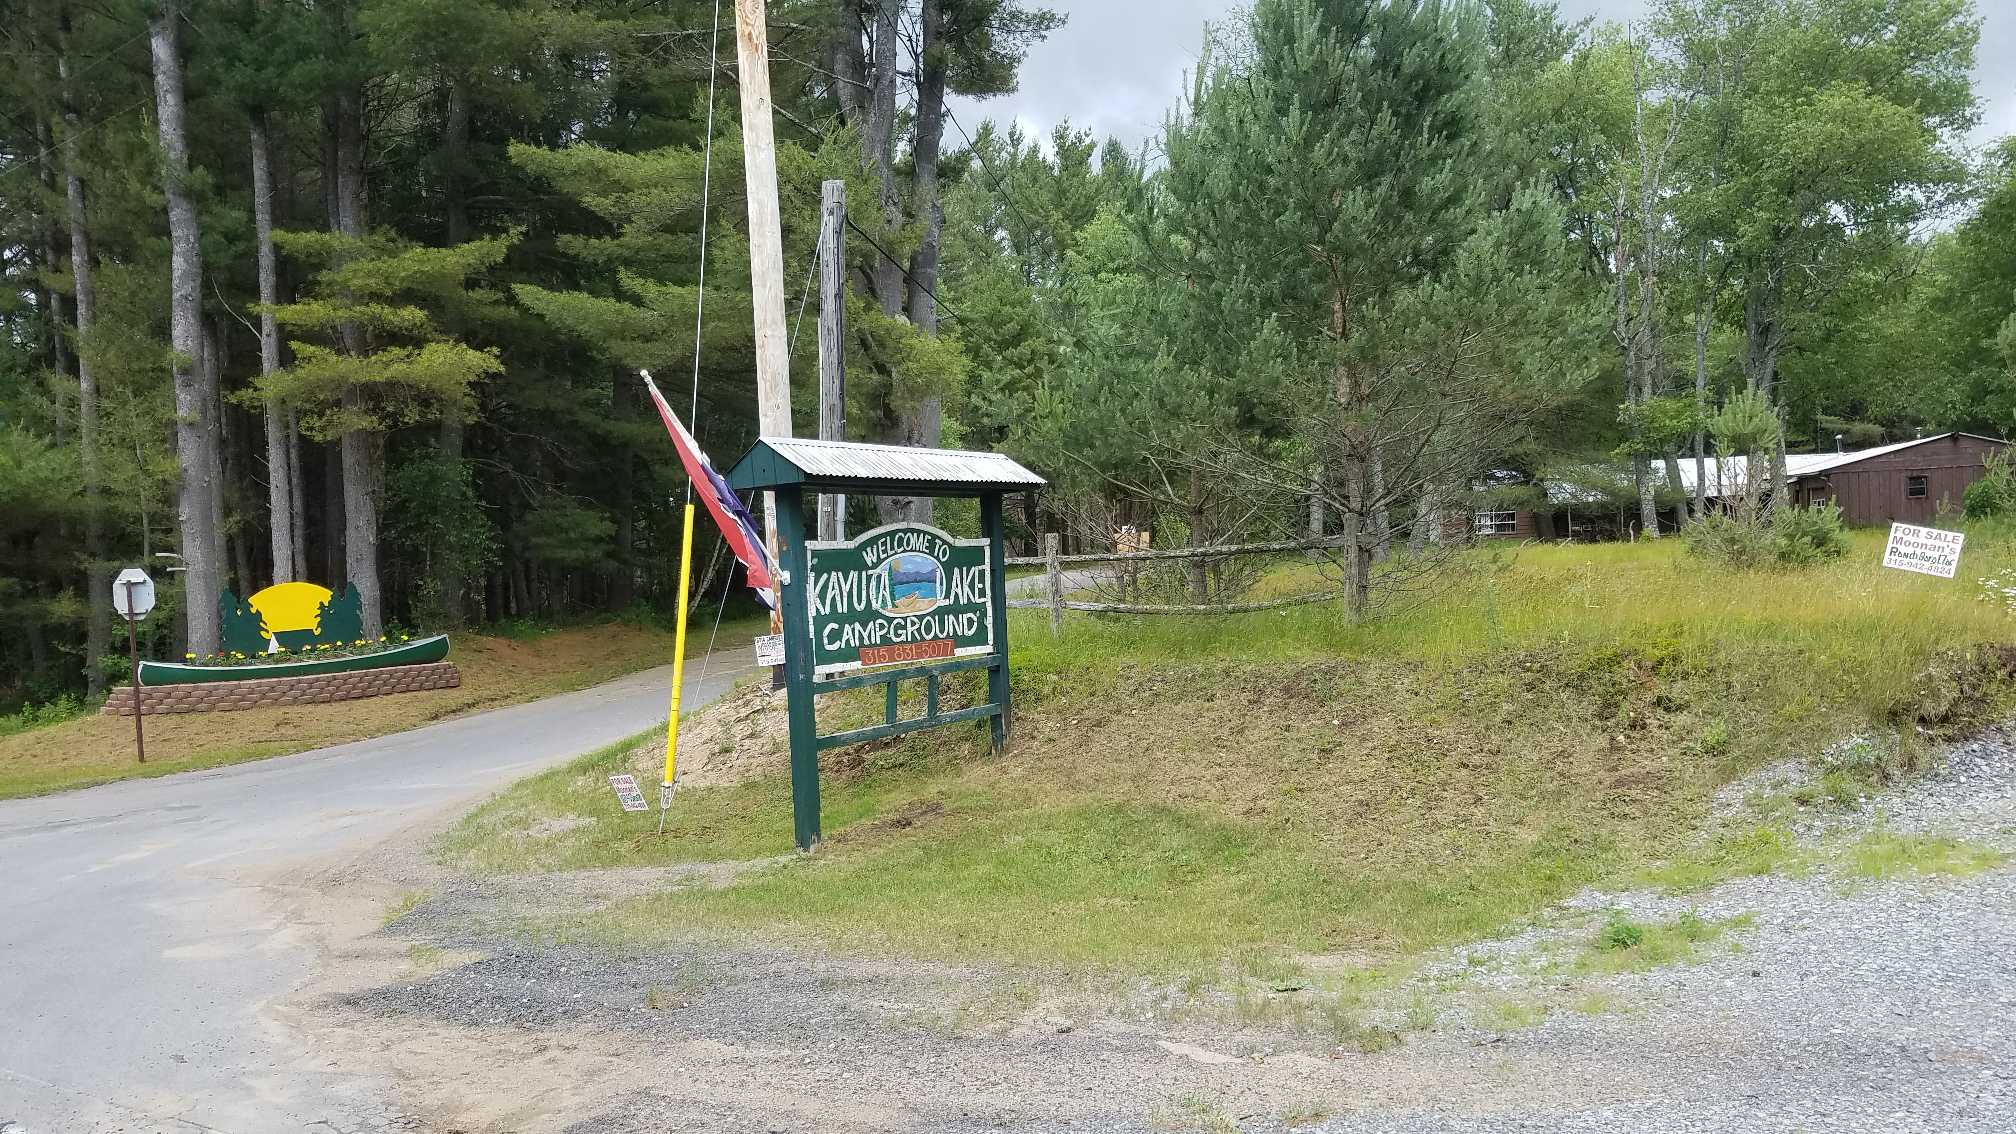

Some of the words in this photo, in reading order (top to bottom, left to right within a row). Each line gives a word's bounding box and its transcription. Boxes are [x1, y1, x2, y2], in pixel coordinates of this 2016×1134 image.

[862, 532, 931, 567] WELCOME
[934, 540, 950, 562] TO
[1892, 536, 1957, 555] Moonan's
[1894, 526, 1921, 537] FOR
[1925, 530, 1960, 544] SALE
[810, 569, 896, 616] KAYUTA
[936, 564, 989, 607] LAKE
[822, 613, 978, 650] CAMPGROUND
[865, 648, 889, 665] 315
[894, 641, 953, 662] 831-5077
